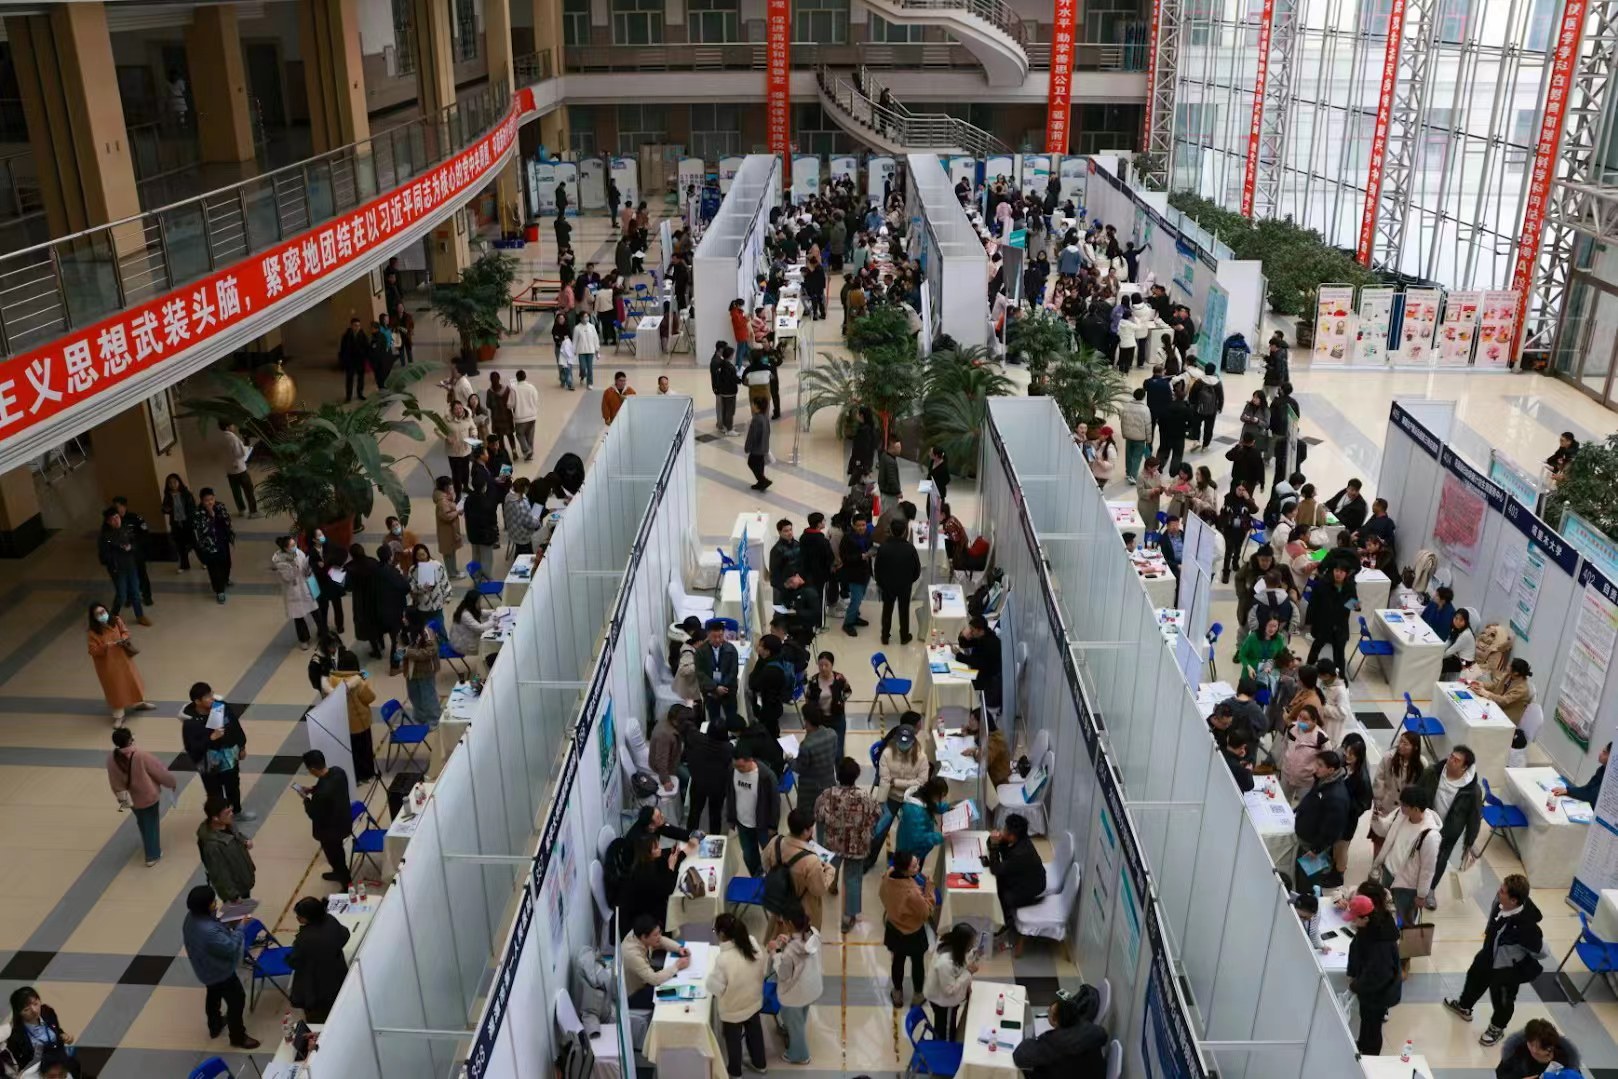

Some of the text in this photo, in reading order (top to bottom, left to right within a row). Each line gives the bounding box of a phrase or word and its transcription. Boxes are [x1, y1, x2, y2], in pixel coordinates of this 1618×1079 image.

[1507, 503, 1518, 519] 403
[1531, 525, 1562, 557] 塔里木大学
[1582, 568, 1595, 585] 402
